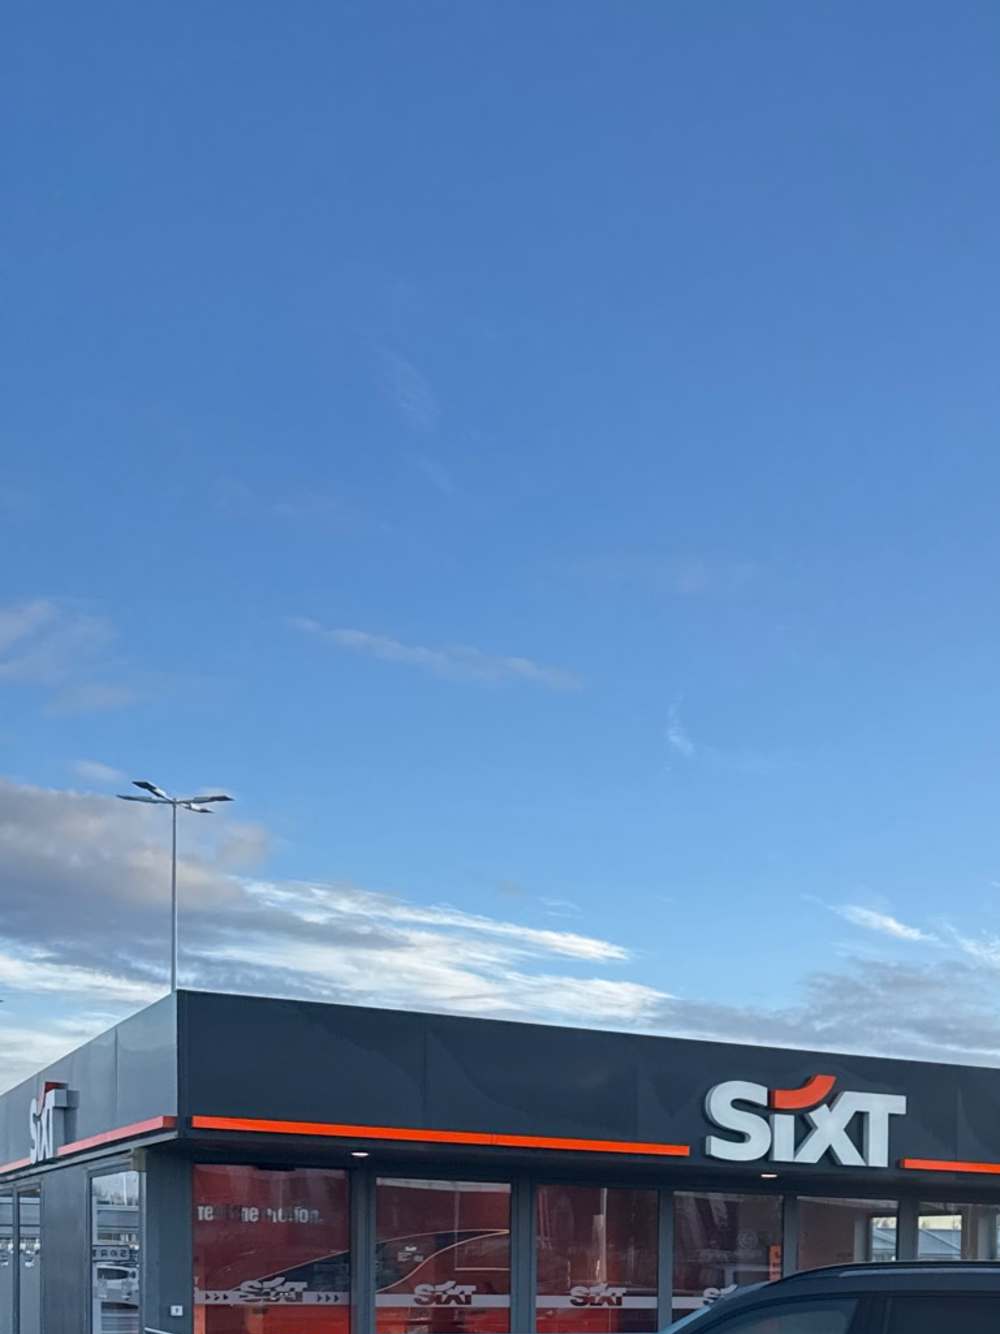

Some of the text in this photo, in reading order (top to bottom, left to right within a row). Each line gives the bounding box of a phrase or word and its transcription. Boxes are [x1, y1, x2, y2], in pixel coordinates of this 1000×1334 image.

[705, 1075, 907, 1168] SIXT
[414, 1281, 477, 1306] SIXT
[570, 1283, 626, 1306] SIXT
